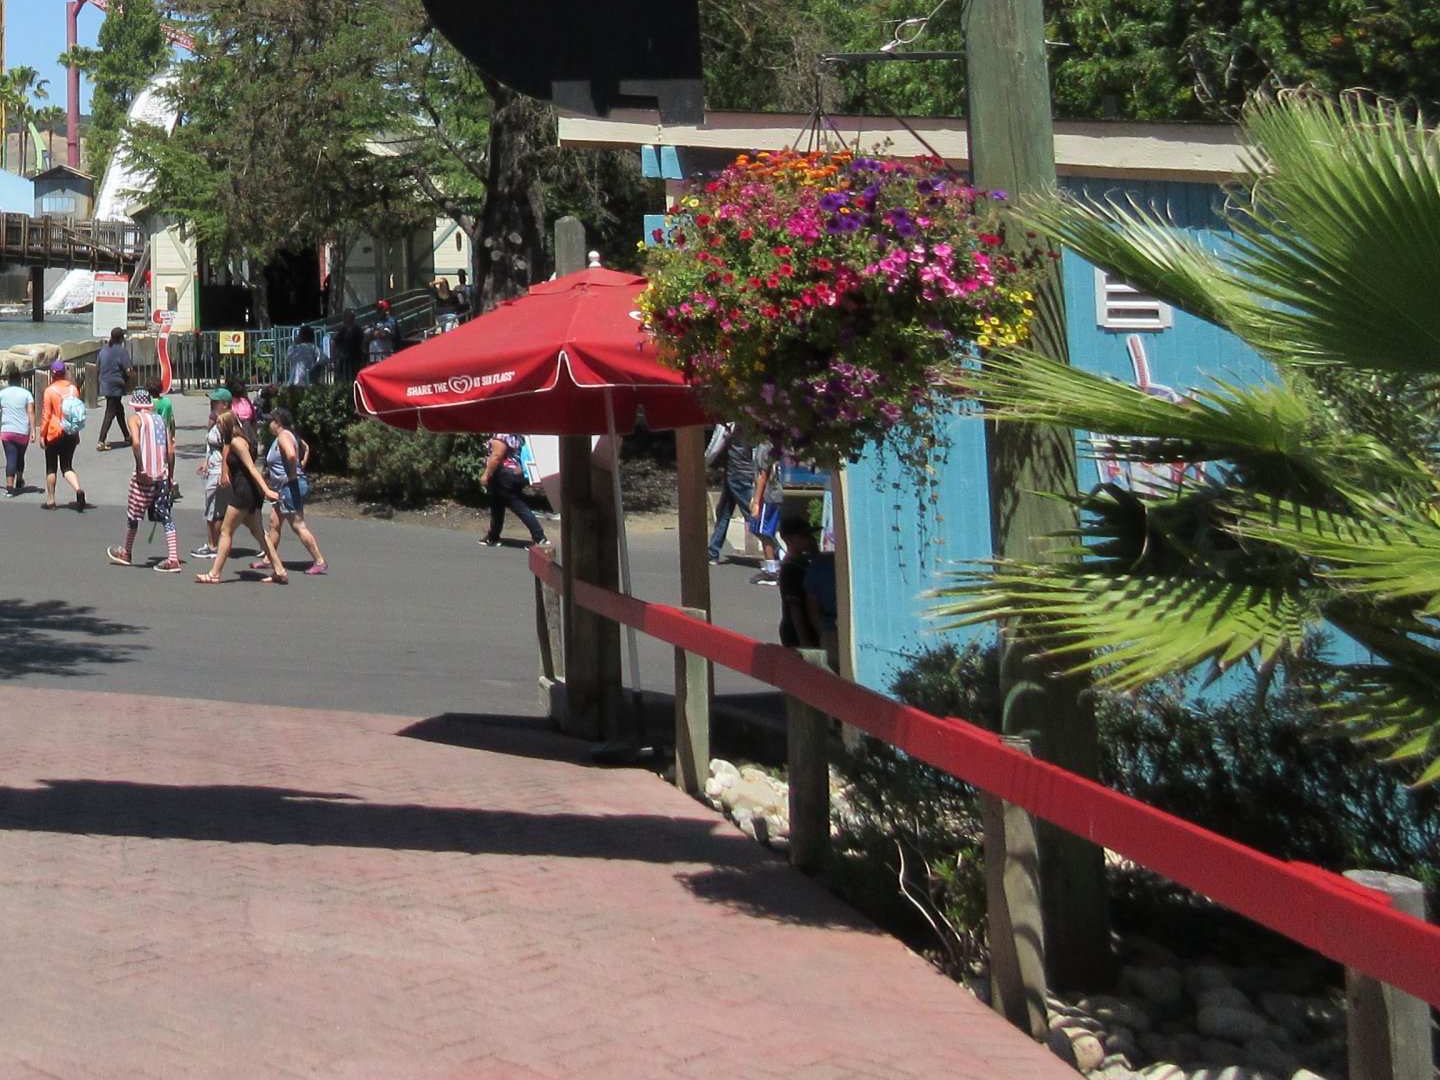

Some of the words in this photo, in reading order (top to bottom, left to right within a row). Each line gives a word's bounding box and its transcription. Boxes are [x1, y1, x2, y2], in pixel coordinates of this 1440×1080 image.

[406, 385, 433, 396] SHARE
[432, 382, 448, 393] THE
[473, 377, 481, 387] AT
[481, 375, 492, 386] SIX
